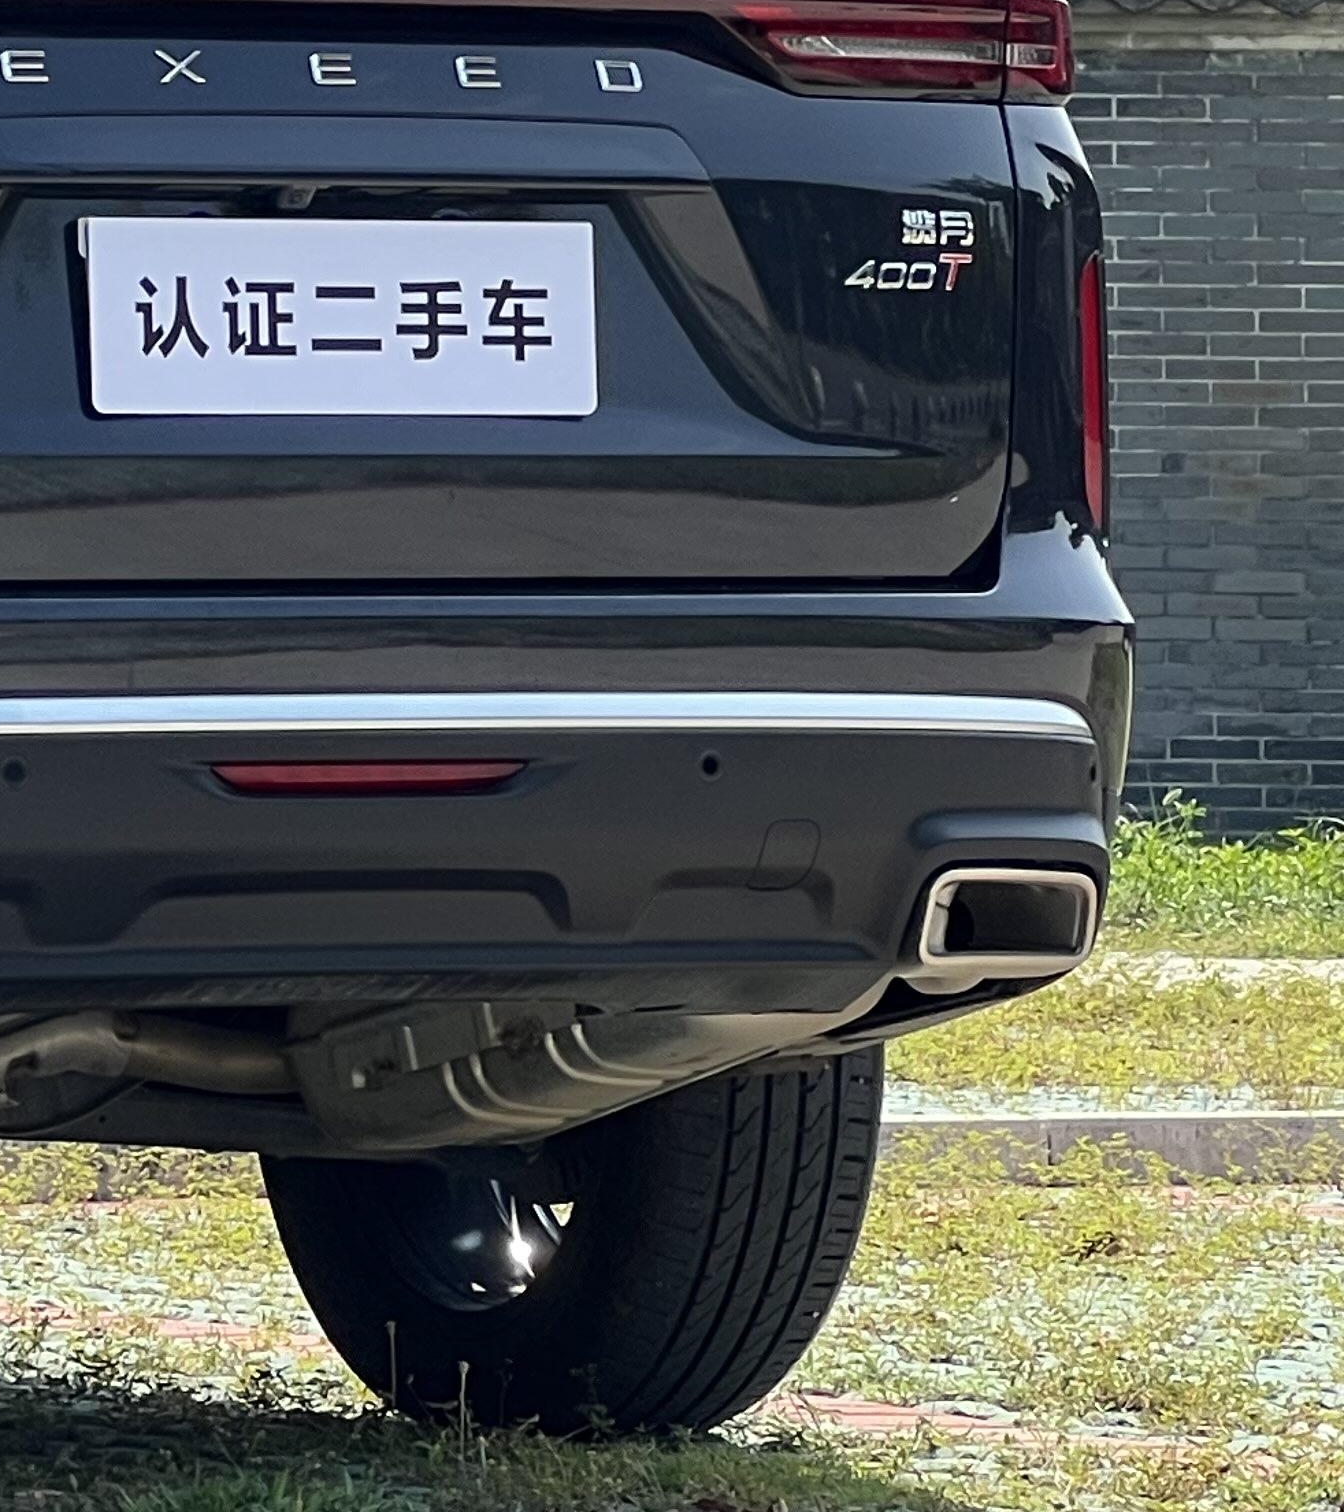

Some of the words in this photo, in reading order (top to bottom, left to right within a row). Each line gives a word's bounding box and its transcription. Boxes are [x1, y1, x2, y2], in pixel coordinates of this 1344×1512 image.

[0, 50, 643, 93] EXEED
[844, 253, 973, 291] 400T
[135, 276, 553, 362] 认证二手车
